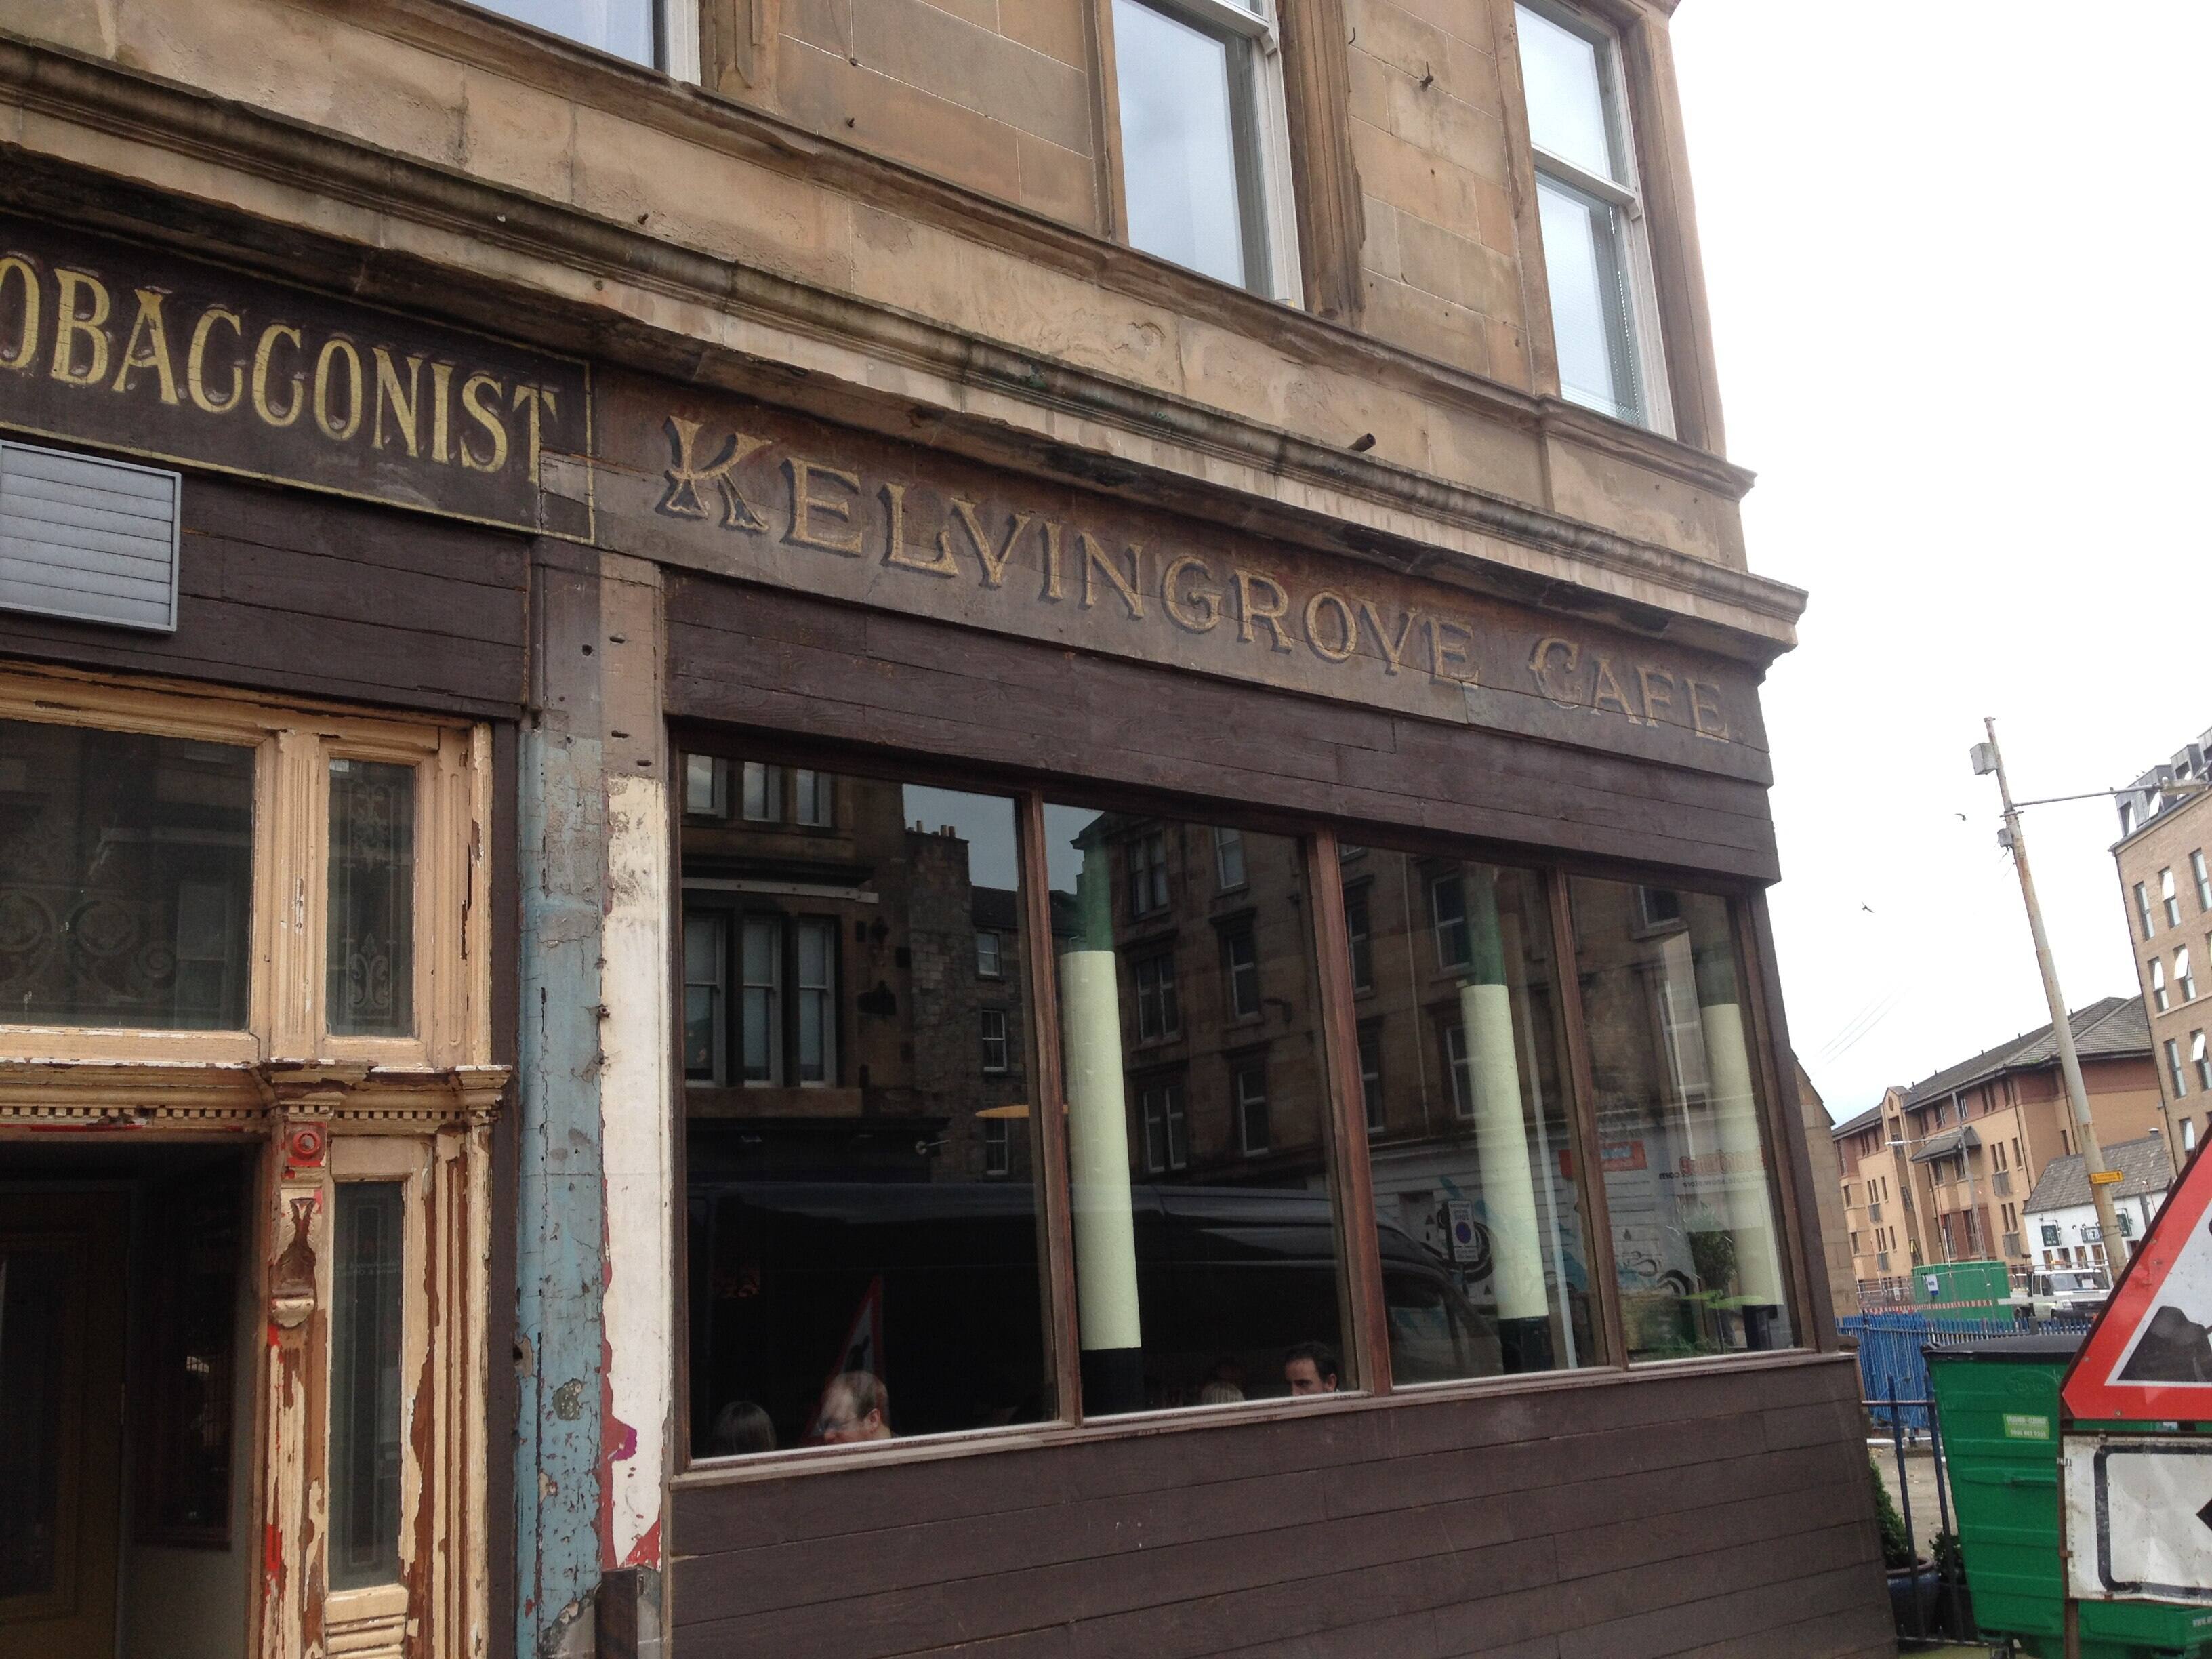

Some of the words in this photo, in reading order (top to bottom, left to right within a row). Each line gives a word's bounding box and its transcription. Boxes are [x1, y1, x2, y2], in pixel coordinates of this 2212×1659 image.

[0, 253, 557, 484] OBACCONIST
[655, 415, 1479, 690] KELVINGROVE
[1528, 636, 1729, 744] CAFE
